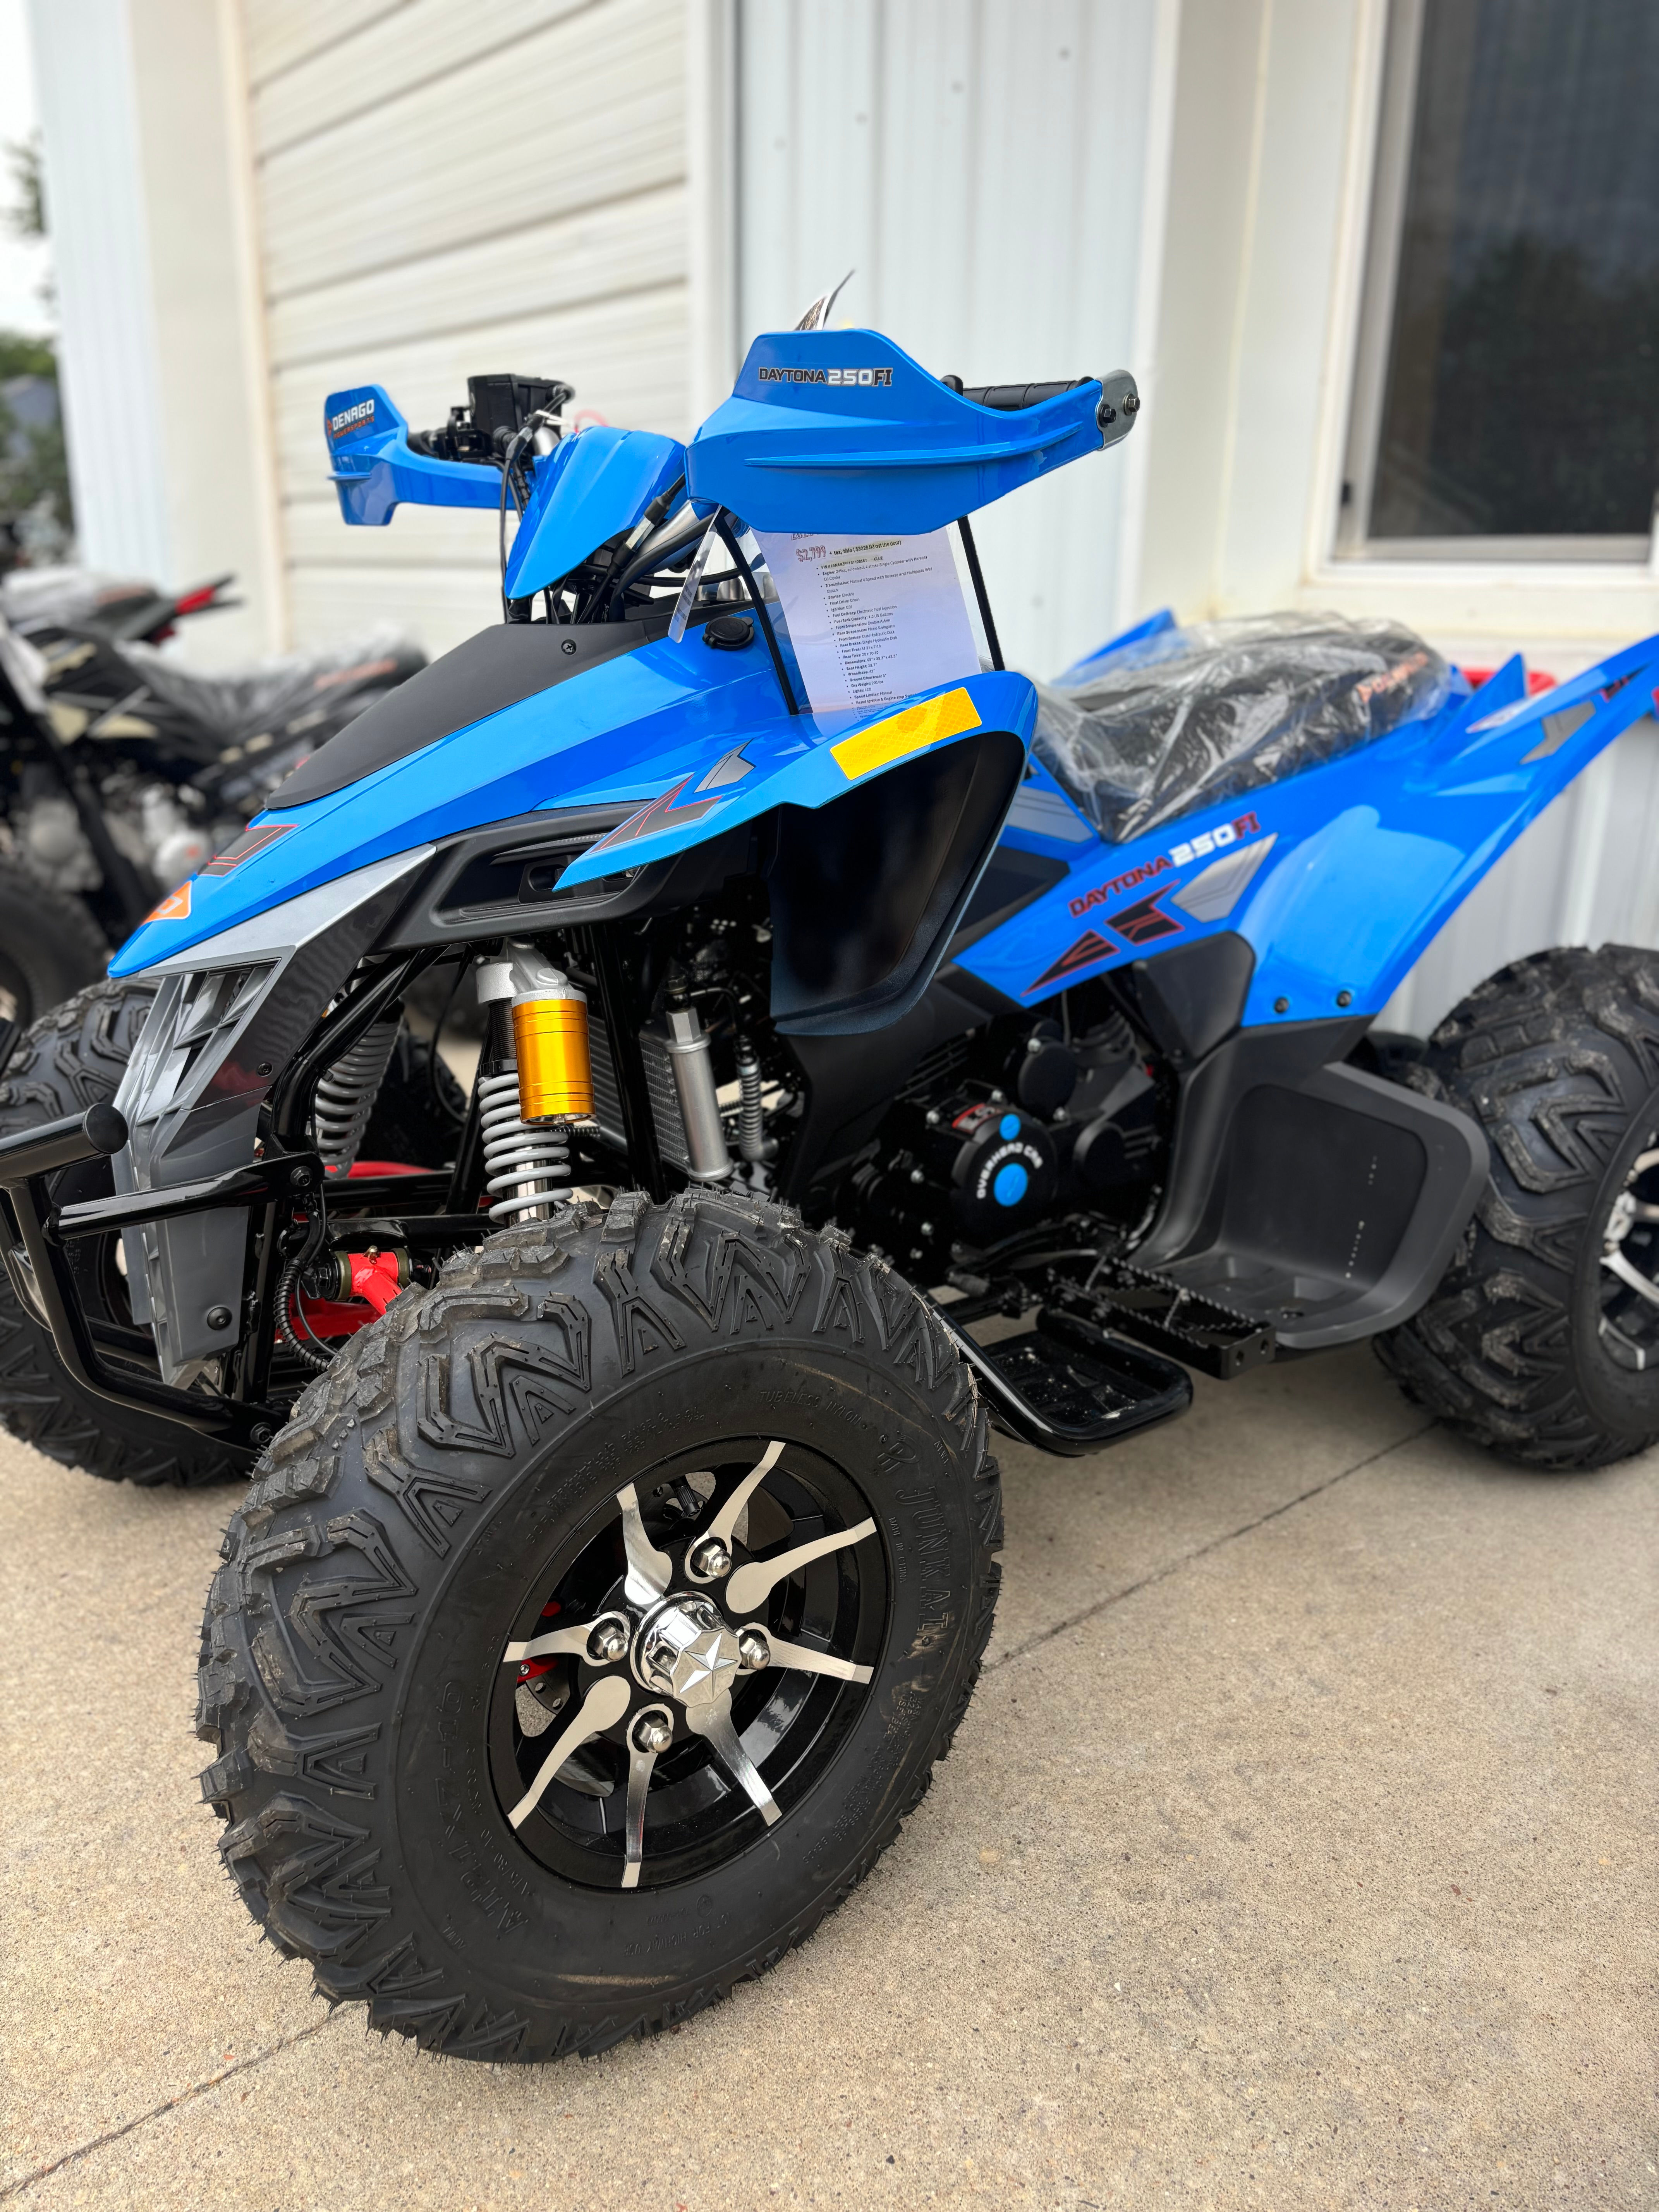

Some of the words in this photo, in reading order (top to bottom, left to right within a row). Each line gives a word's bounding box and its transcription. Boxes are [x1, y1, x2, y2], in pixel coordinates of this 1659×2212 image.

[759, 367, 826, 384] DAYTONA
[827, 368, 893, 387] 250FI
[332, 399, 374, 431] DENAGO
[333, 416, 374, 439] POWERSPORTS
[796, 545, 826, 562] $2,799
[1068, 855, 1174, 919] DAYTONA
[1169, 811, 1261, 868] 250FI
[760, 1391, 822, 1407] TUBELESS
[825, 1401, 862, 1425] NYLON
[895, 1542, 904, 1551] IN
[895, 1486, 951, 1632] JUNKAI
